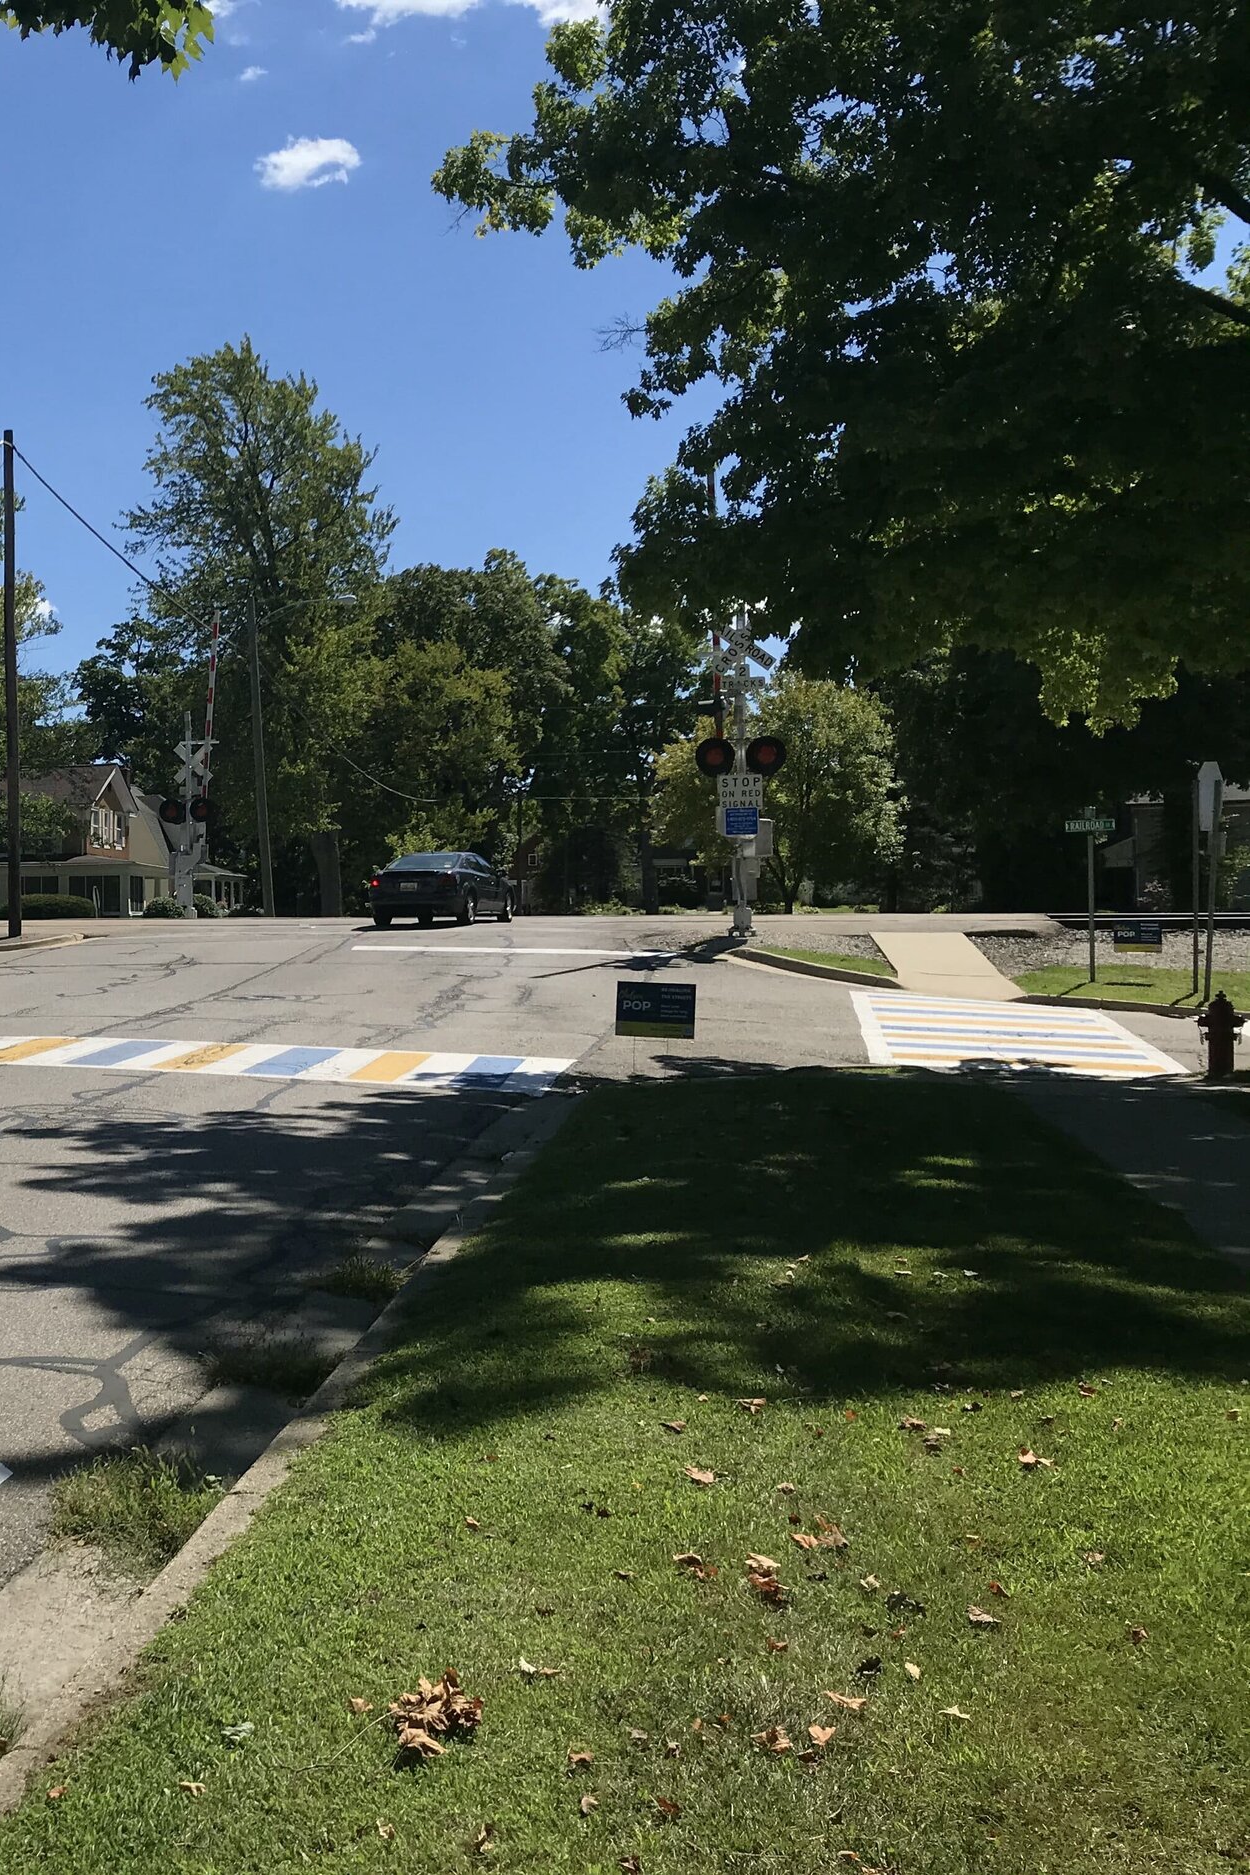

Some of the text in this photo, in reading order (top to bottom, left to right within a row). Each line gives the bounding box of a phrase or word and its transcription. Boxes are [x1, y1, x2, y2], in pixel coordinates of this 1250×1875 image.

[739, 666, 746, 677] 2
[721, 777, 760, 788] STOP
[721, 789, 761, 798] ON RED
[721, 800, 761, 808] SIGNAL
[1070, 821, 1103, 830] RAILROAD
[1117, 930, 1136, 938] POP
[622, 1000, 651, 1011] POP
